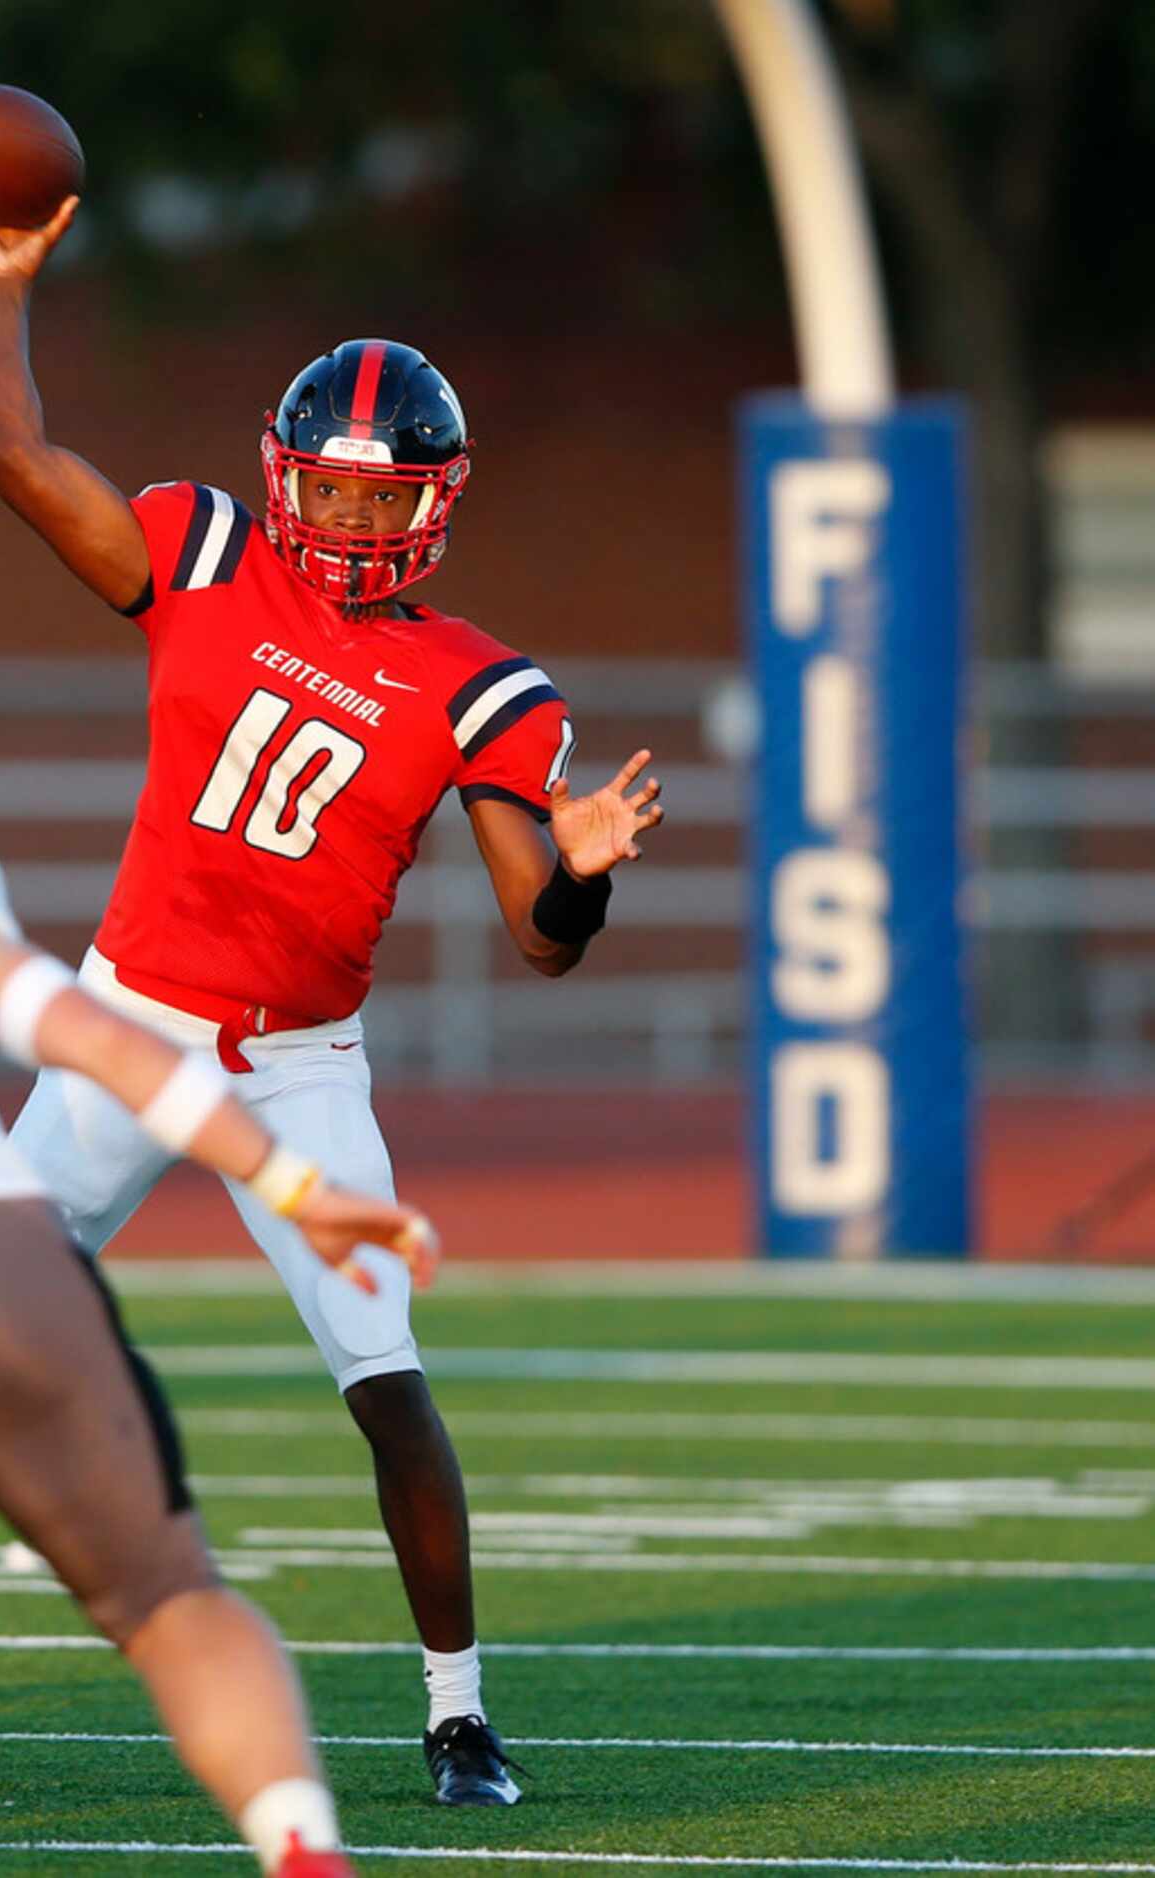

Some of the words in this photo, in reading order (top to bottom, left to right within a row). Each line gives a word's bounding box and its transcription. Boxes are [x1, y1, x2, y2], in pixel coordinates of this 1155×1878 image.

[251, 641, 386, 727] CENTENNIAL
[190, 686, 367, 861] 10
[769, 458, 891, 1217] FISD
